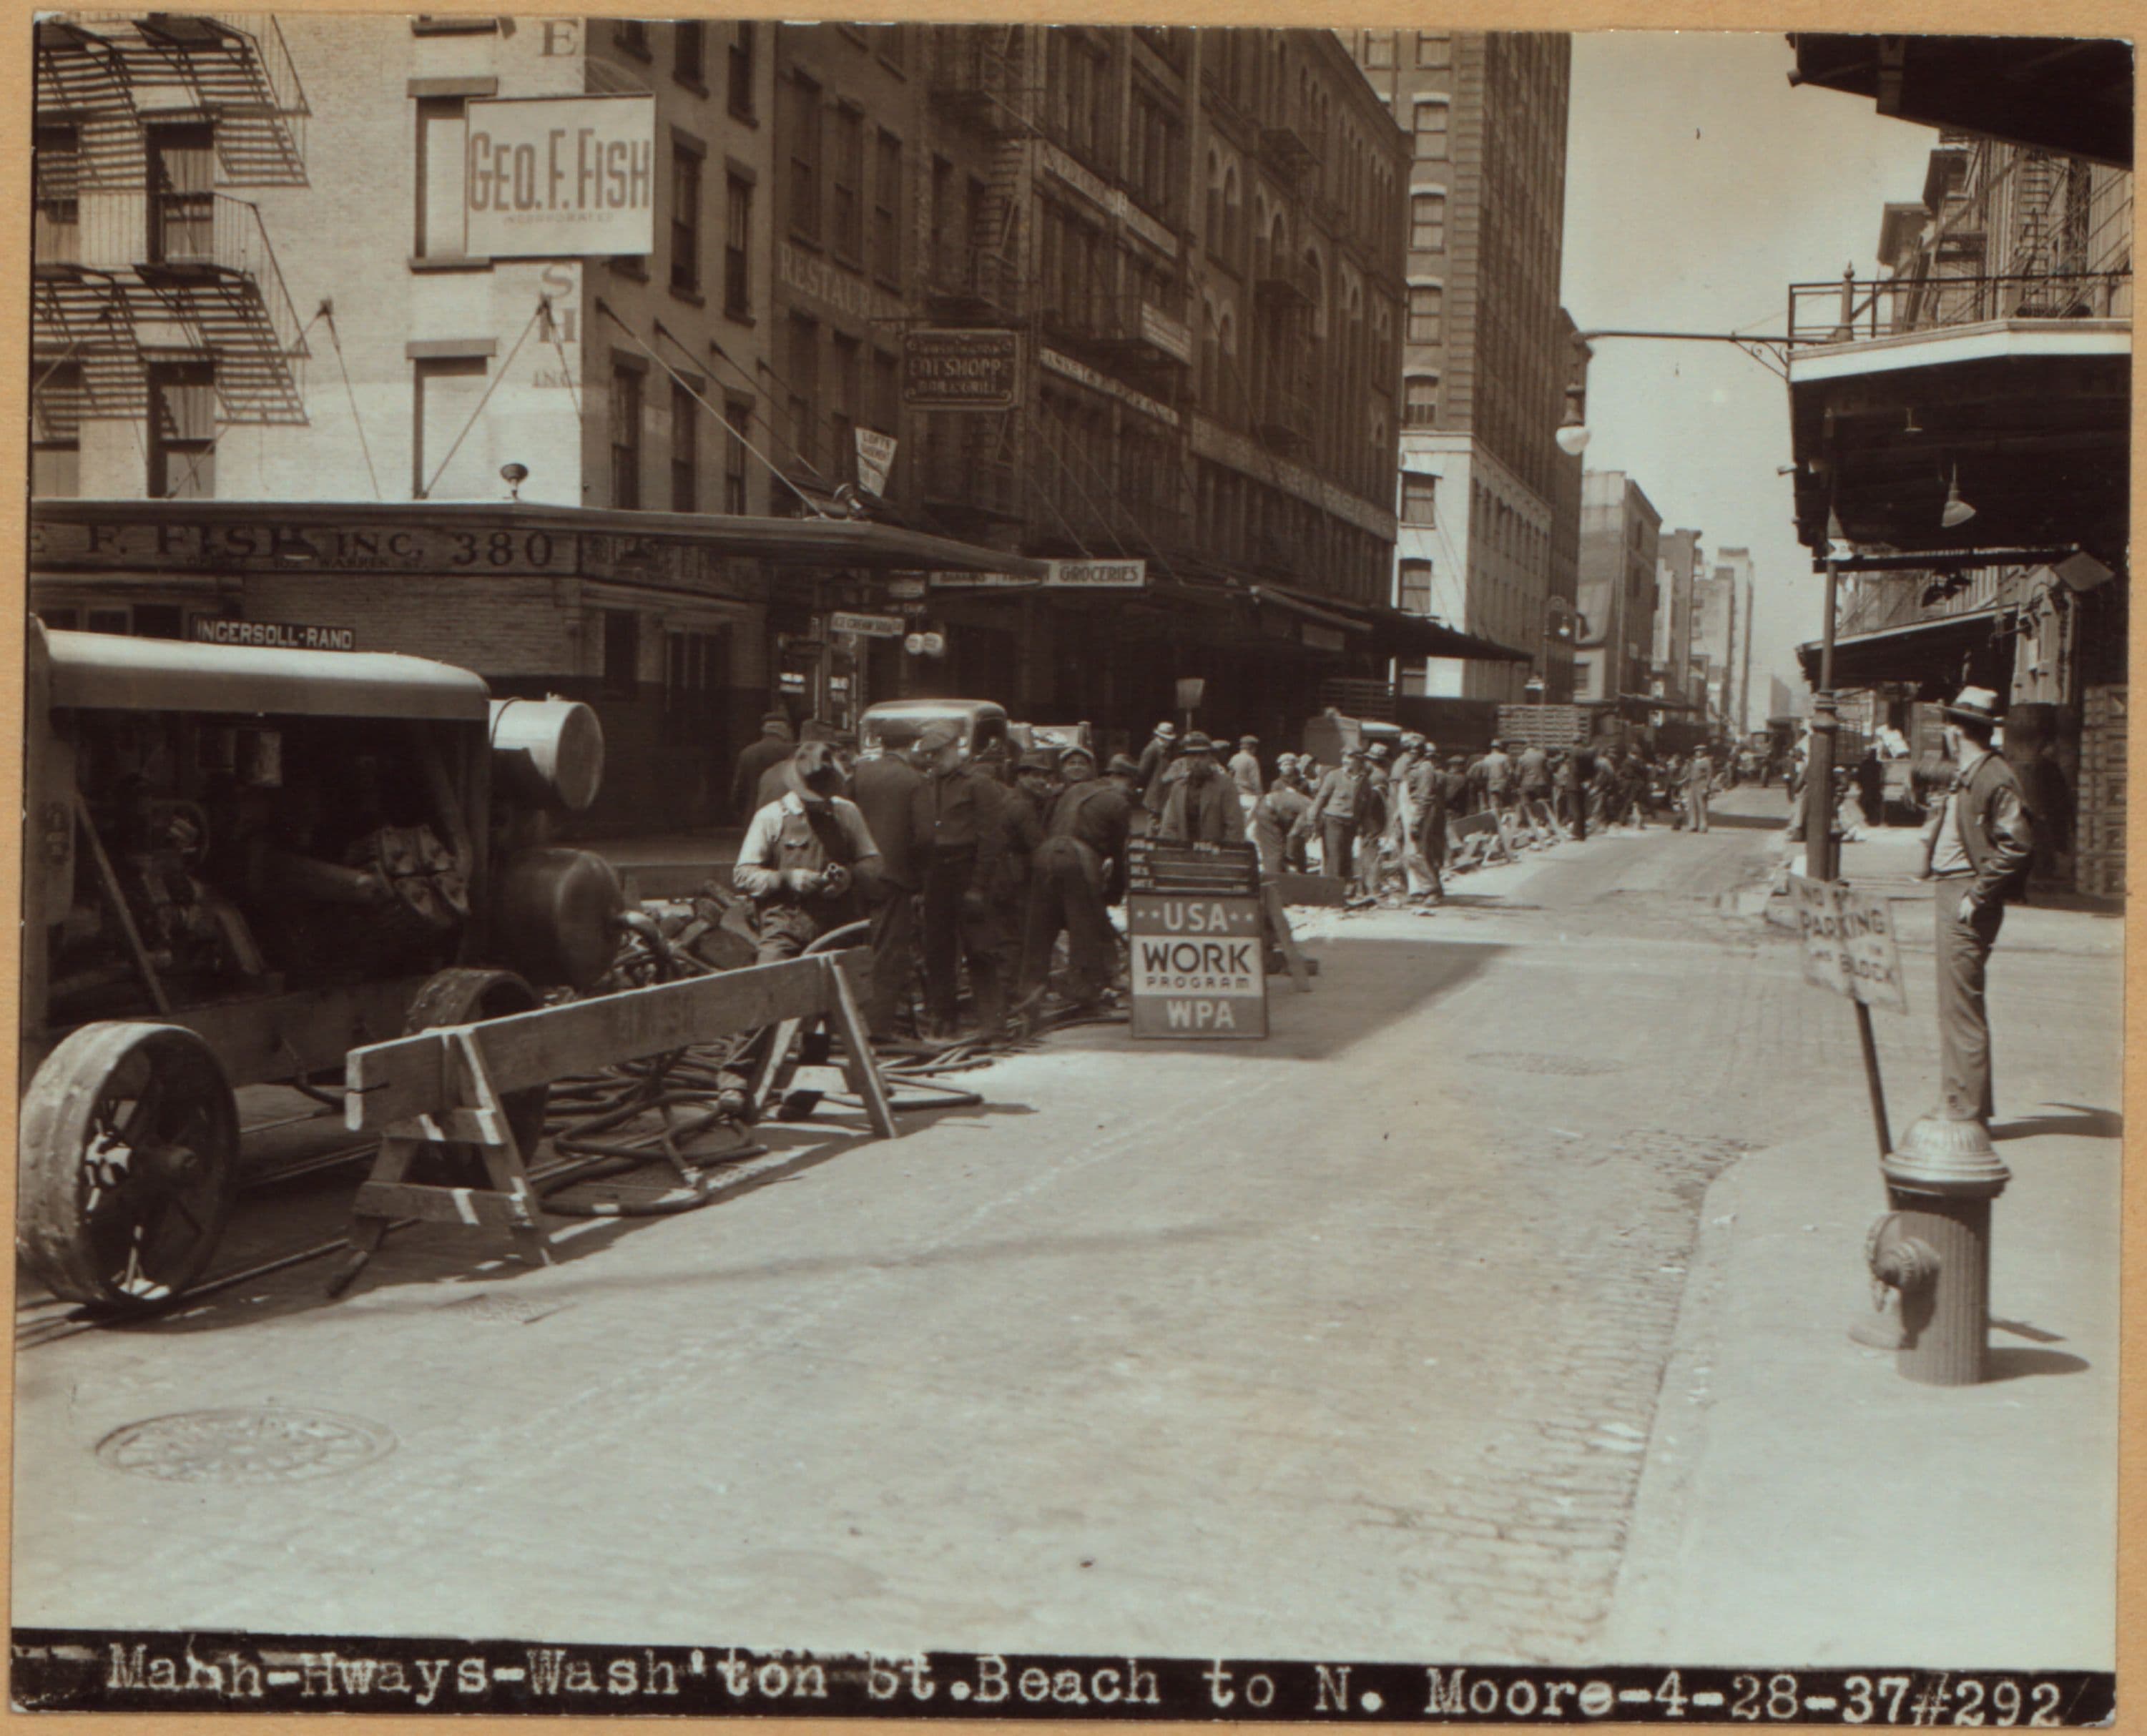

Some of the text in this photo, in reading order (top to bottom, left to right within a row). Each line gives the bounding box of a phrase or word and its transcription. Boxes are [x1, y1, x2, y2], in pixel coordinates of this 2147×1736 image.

[537, 19, 578, 57] E
[577, 127, 651, 209] FISH
[87, 524, 127, 556] F.
[451, 531, 554, 567] 380
[1059, 565, 1139, 583] GROCERIES
[197, 619, 353, 649] INGERSOLL-RAND
[1164, 902, 1229, 932] USA
[1799, 908, 1886, 942] PARKING
[1142, 942, 1251, 975] WORK
[1146, 975, 1249, 990] PROGRAM
[1166, 1000, 1236, 1030] WPA
